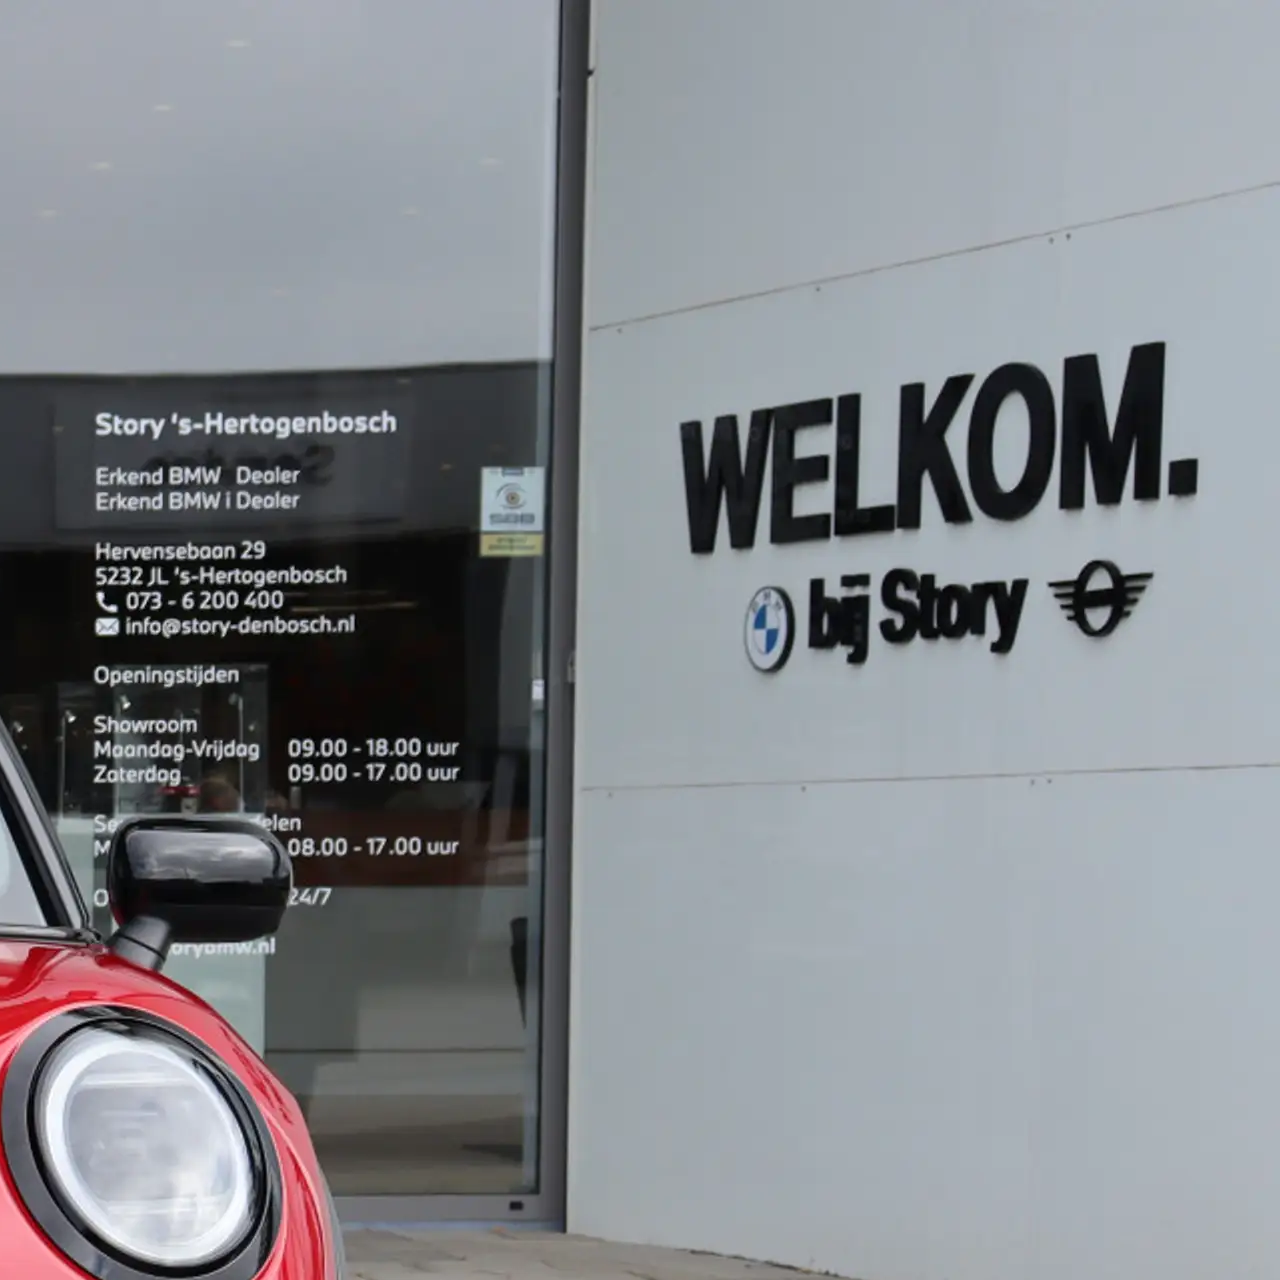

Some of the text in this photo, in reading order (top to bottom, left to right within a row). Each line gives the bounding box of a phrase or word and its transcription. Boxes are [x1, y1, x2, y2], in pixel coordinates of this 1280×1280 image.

[96, 413, 165, 439] Story
[680, 342, 1198, 554] WELKOM.
[96, 466, 300, 485] Erkend BMW Dealer
[96, 491, 299, 510] Erkend BMW i Dealer
[96, 541, 265, 560] Hervensebaan 29
[96, 567, 142, 585] 5232
[148, 568, 168, 586] JL
[127, 592, 161, 609] 073
[182, 592, 194, 609] 6
[200, 591, 238, 609] 200
[244, 591, 283, 608] 400
[126, 615, 354, 637] info@story-denbosch.nl
[809, 569, 1028, 665] bij Story
[95, 666, 239, 687] Openingstijden
[94, 716, 197, 733] Showroom
[95, 740, 259, 762] Maandag-Vrijdag
[289, 739, 347, 757] 09.00
[367, 738, 421, 756] 18.00
[427, 743, 459, 756] uur
[94, 765, 180, 786] Zaterdag
[289, 764, 346, 781] 09.00
[367, 763, 421, 781] 17.00
[428, 768, 459, 781] uur
[287, 837, 348, 858] 08.00
[367, 837, 421, 855] 17.00
[428, 842, 459, 855] uur
[289, 887, 332, 905] 24/7
